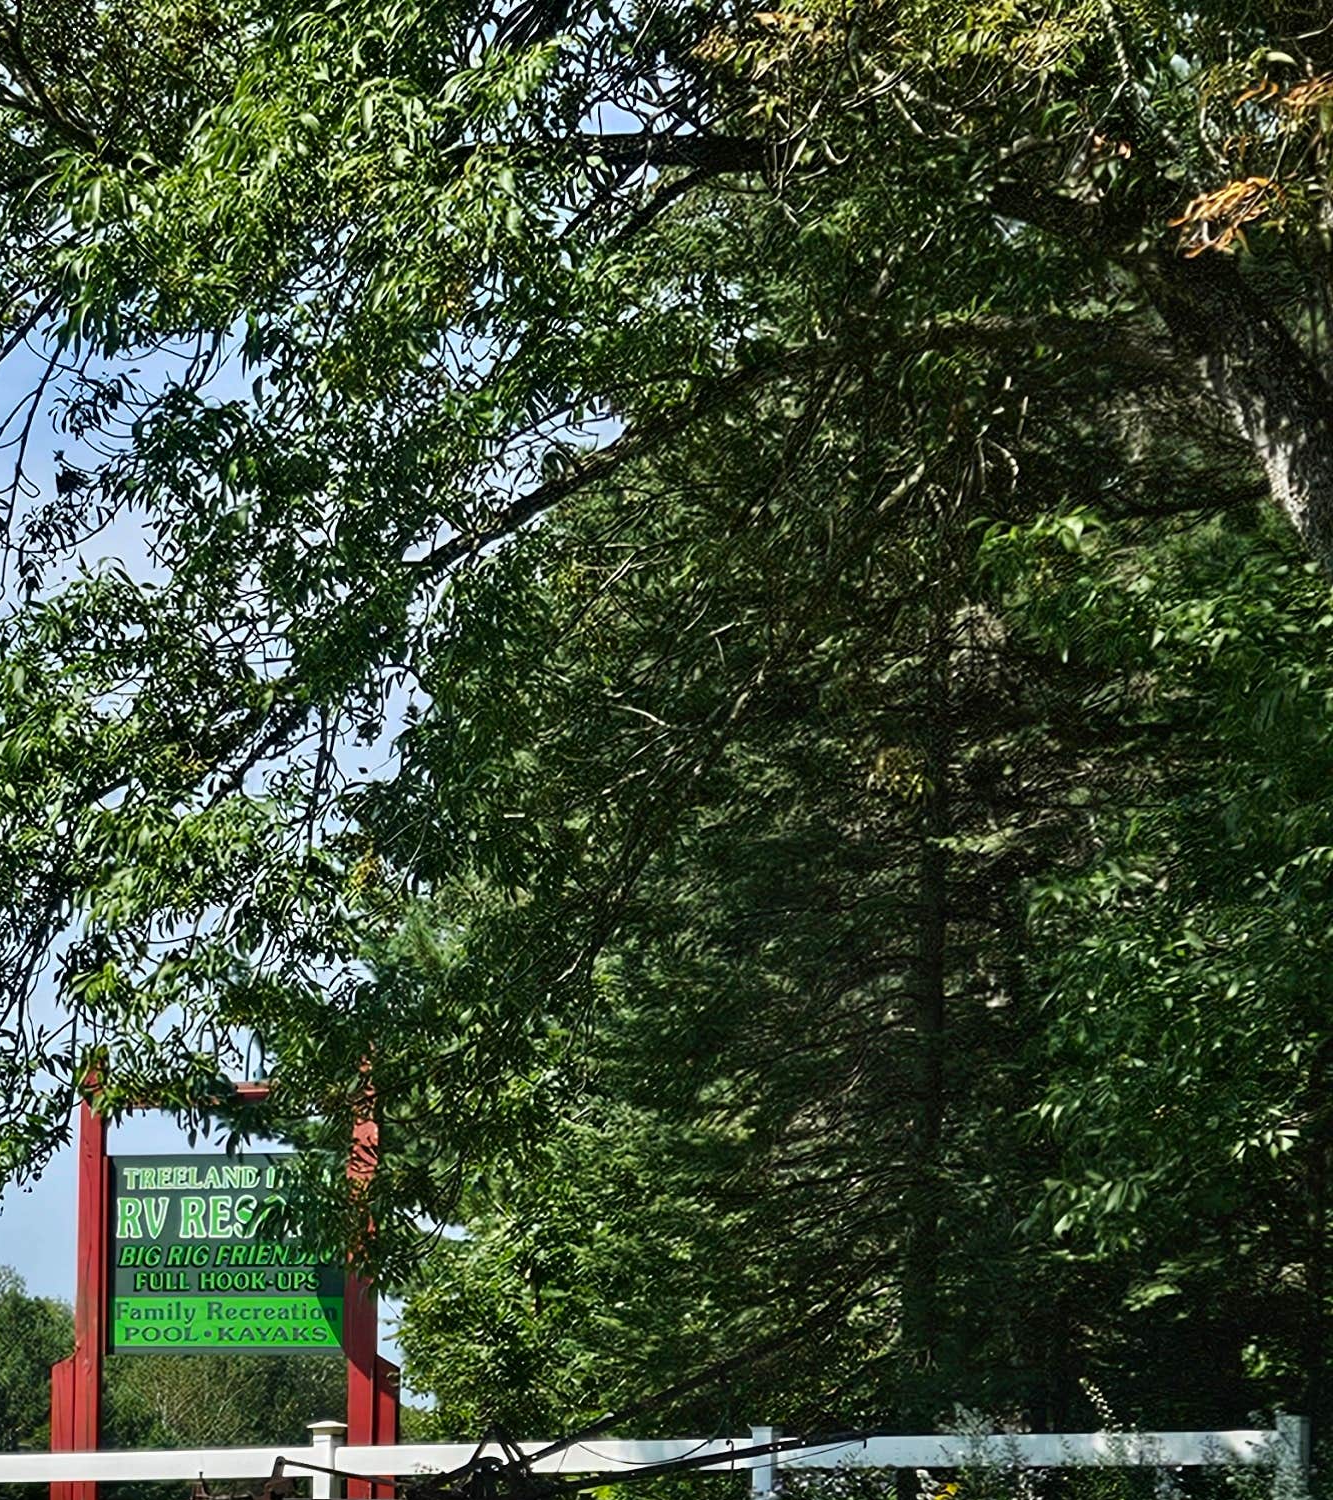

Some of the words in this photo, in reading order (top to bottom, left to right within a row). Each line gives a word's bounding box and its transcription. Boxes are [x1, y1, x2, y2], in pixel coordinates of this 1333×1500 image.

[123, 1166, 261, 1190] TREELAND
[116, 1196, 170, 1239] RV
[179, 1194, 303, 1239] RES
[118, 1244, 163, 1267] BIG
[165, 1244, 211, 1267] RIG
[134, 1271, 190, 1291] FULL
[198, 1271, 321, 1291] HOOK-UPS
[116, 1301, 196, 1324] Family
[206, 1301, 338, 1321] Recreation
[124, 1326, 199, 1342] POOL
[217, 1326, 328, 1342] KAYAKS
